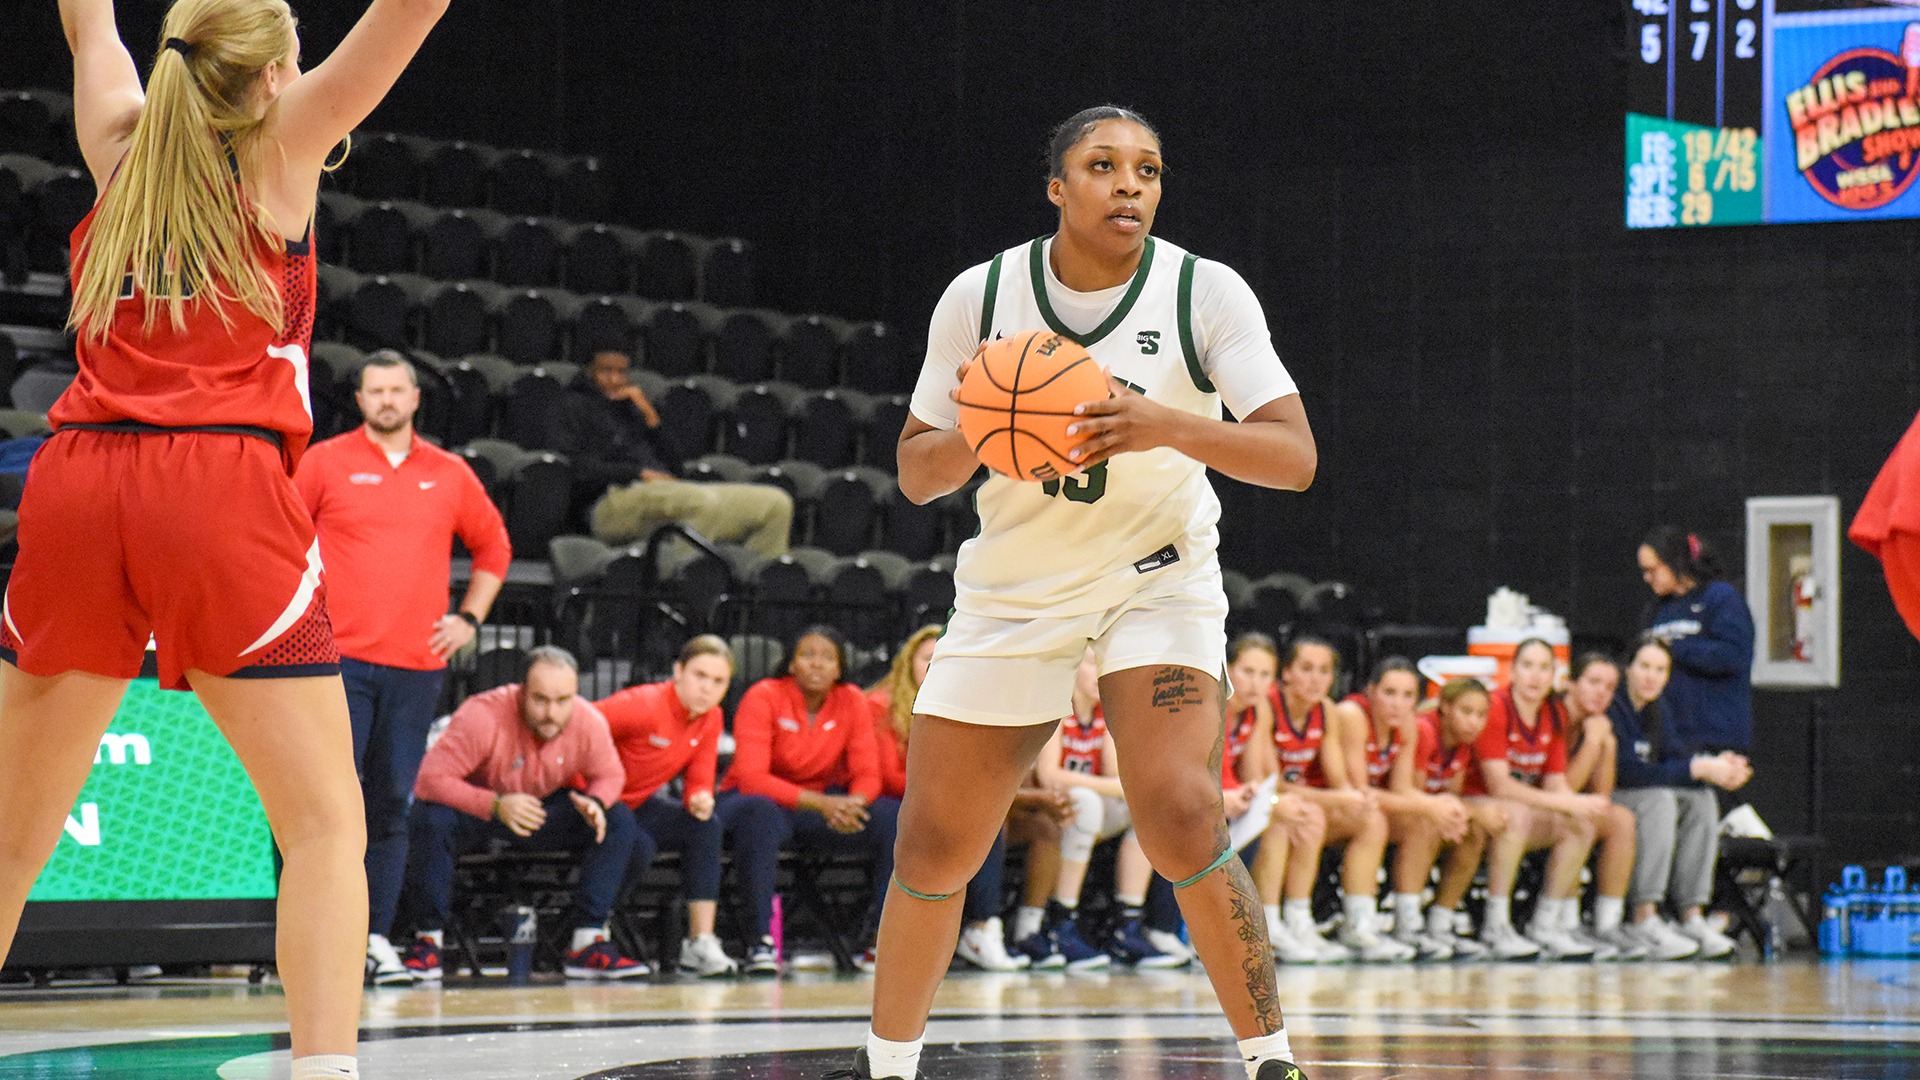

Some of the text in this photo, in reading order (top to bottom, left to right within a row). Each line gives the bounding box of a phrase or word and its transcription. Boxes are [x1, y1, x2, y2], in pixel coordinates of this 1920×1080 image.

[1640, 18, 1756, 64] 5 7 2
[1787, 70, 1867, 130] ELLIS
[1796, 97, 1920, 172] BRADLE
[1681, 191, 1713, 225] 29
[1161, 551, 1174, 561] XL
[1153, 667, 1185, 686] walk
[1152, 682, 1185, 707] faith
